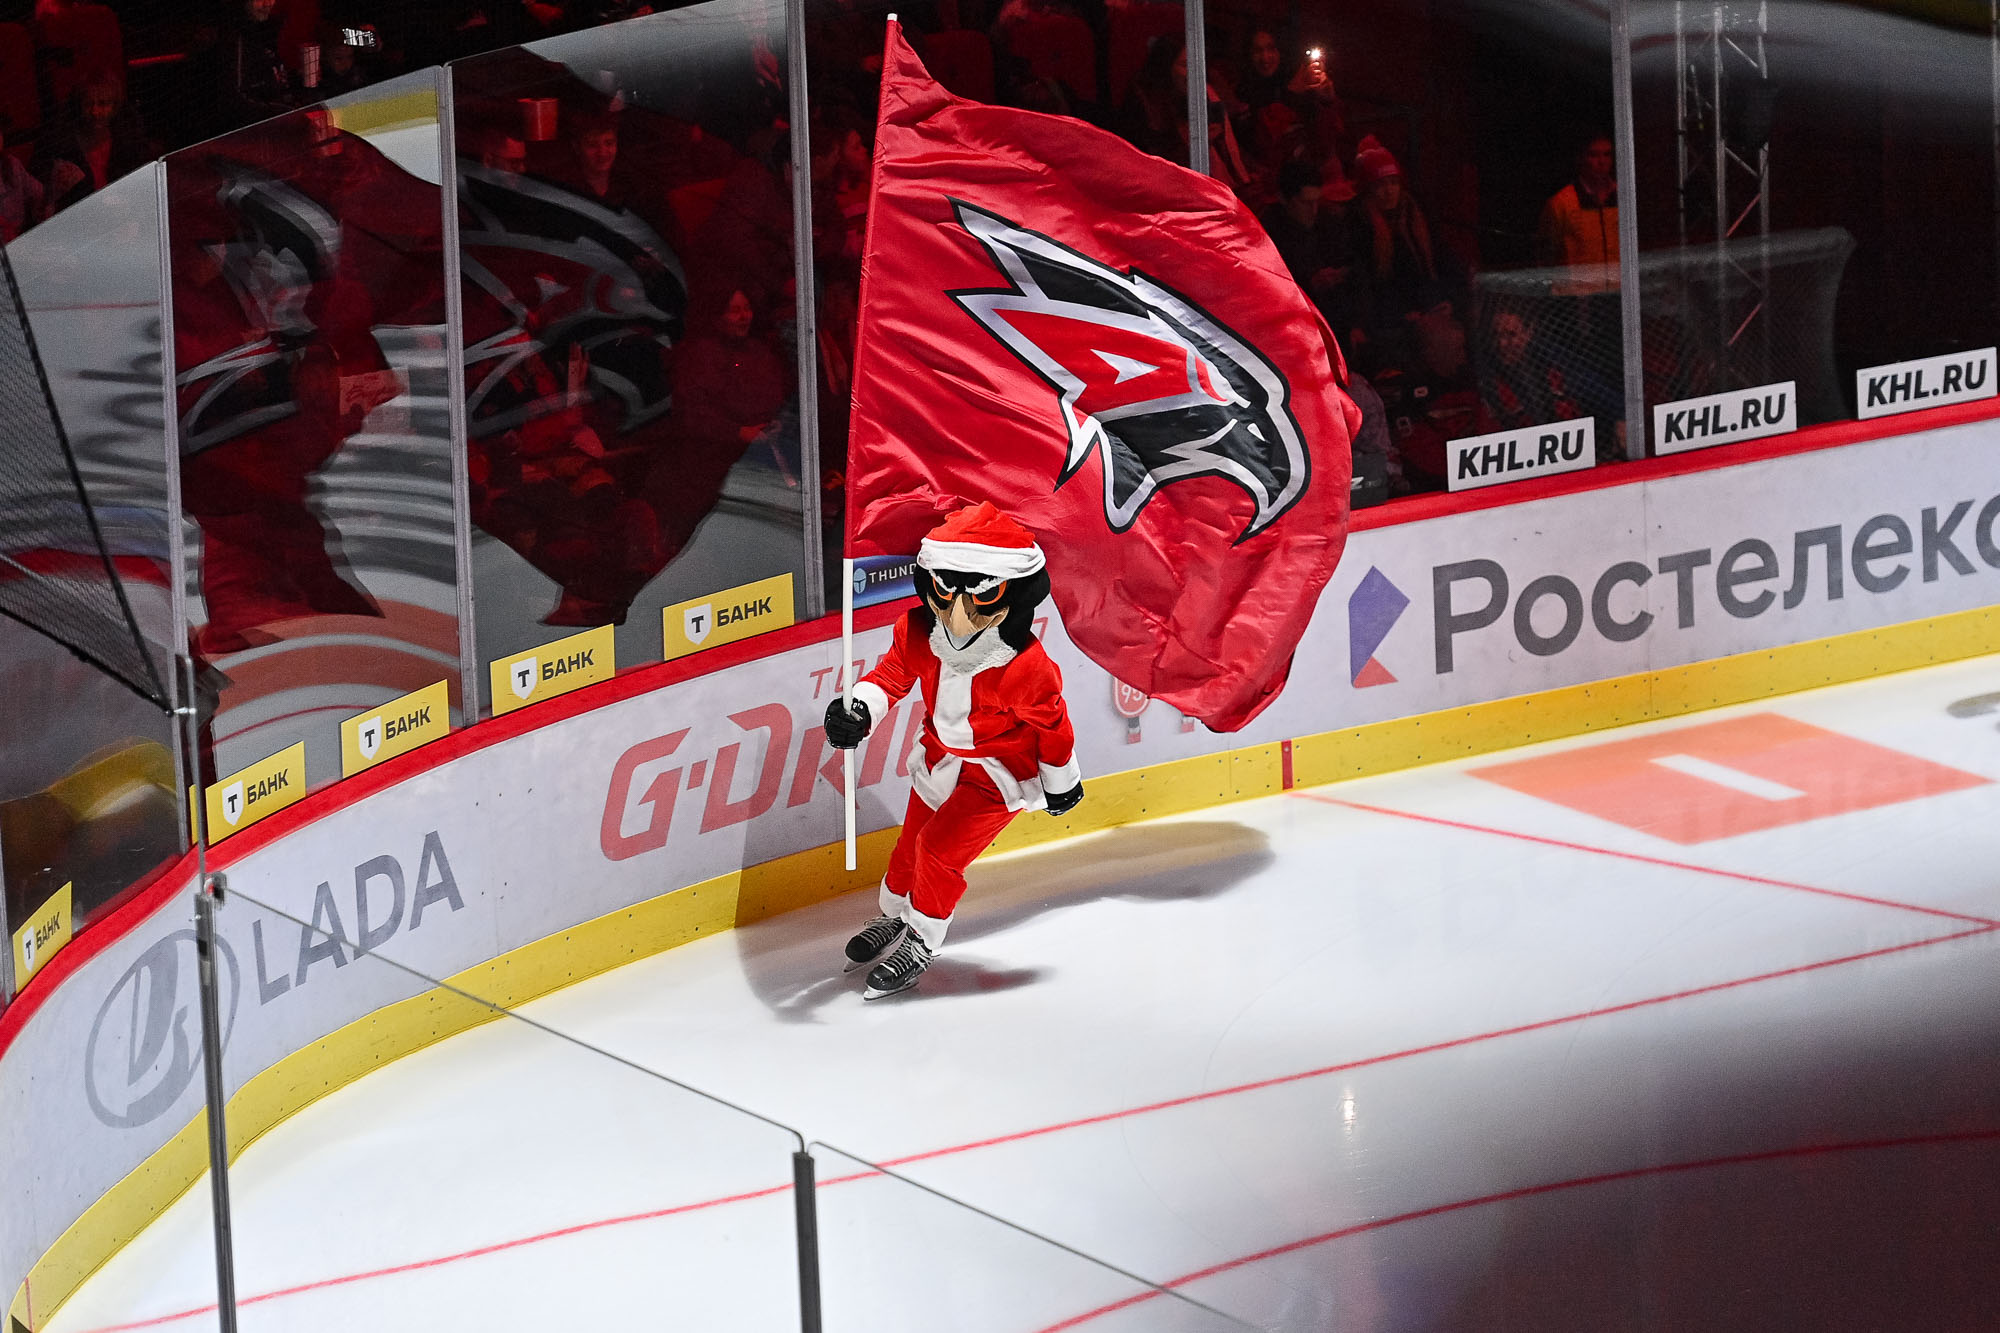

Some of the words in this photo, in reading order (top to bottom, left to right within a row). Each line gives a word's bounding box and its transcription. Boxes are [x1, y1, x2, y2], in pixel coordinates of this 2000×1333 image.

[1866, 359, 1988, 407] KHL.RU
[1664, 393, 1787, 443] KHL.RU
[1457, 429, 1584, 479] KHL.RU
[716, 596, 772, 627] БАНК
[542, 648, 594, 681] БАНК
[385, 706, 431, 740] БАНК
[247, 768, 289, 805] БАНК
[36, 911, 60, 950] БАНК
[252, 830, 465, 1006] LADA
